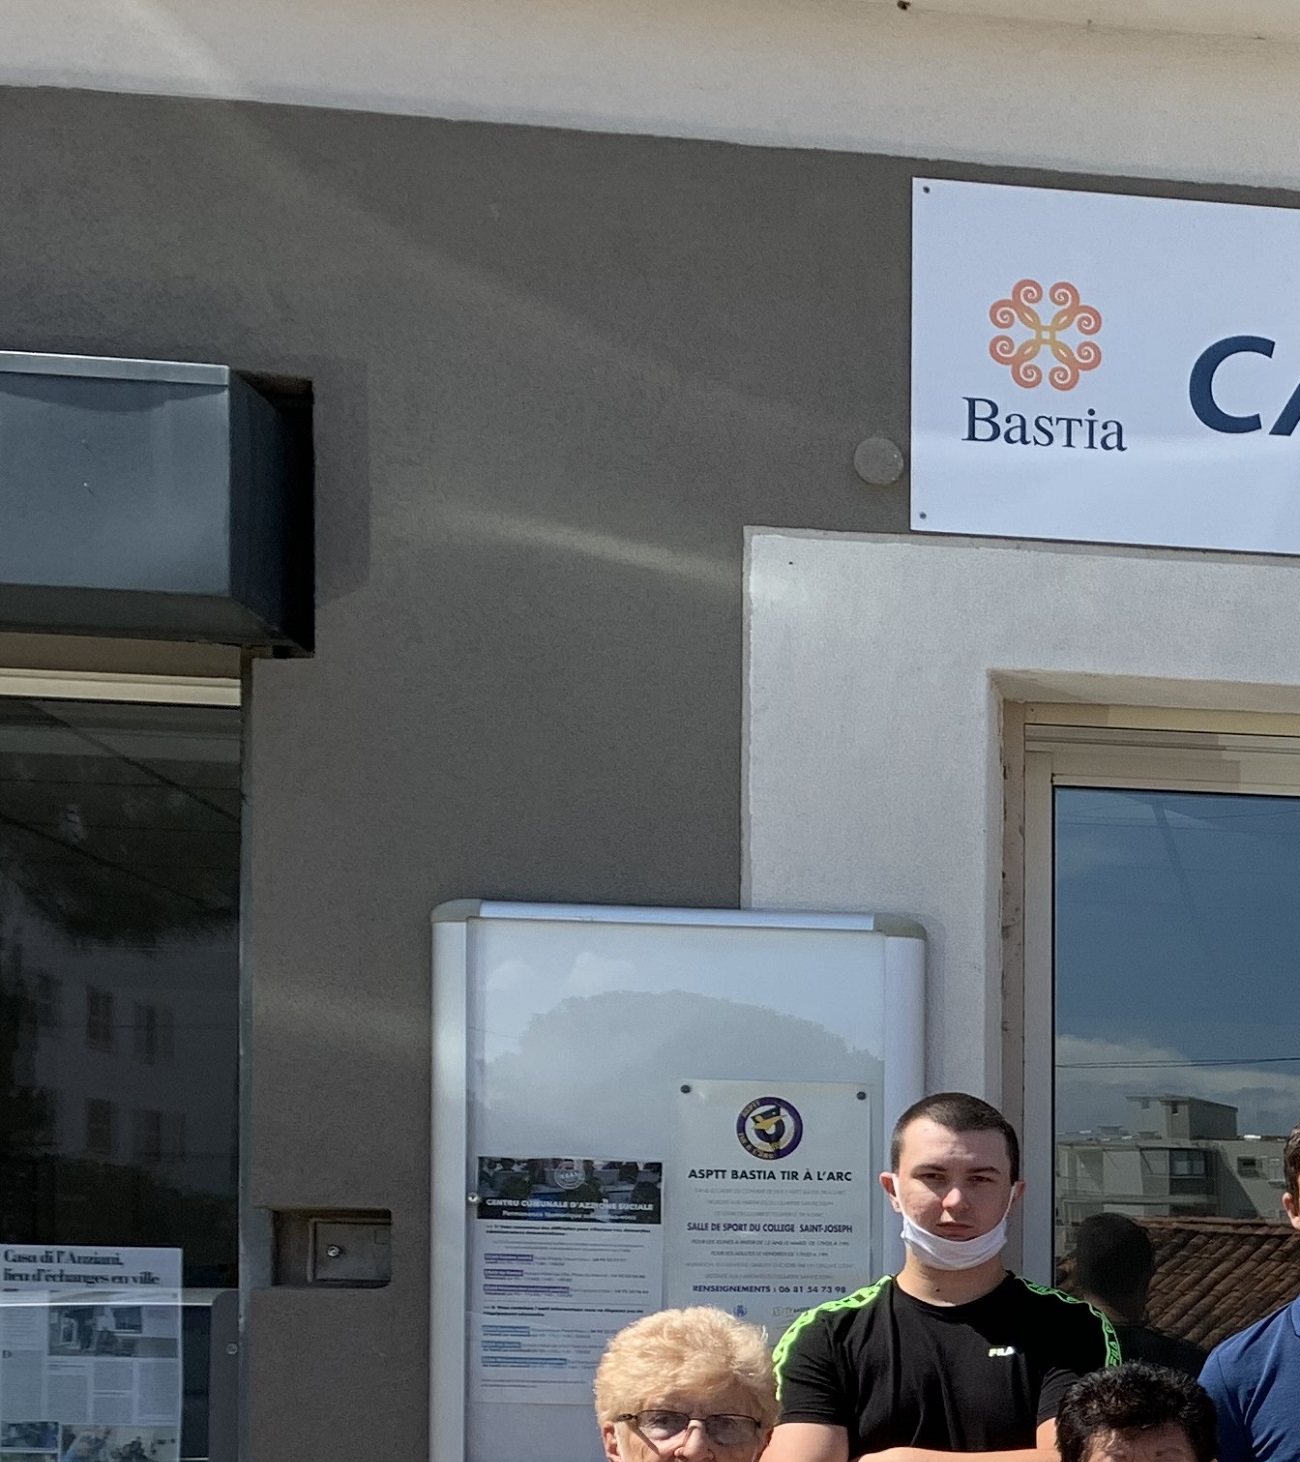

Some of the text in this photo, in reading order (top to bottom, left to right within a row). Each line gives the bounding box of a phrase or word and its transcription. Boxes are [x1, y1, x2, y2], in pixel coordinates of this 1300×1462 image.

[688, 1168, 852, 1182] ASPTT BASTIA TIR À L'ARC
[486, 1199, 520, 1207] CENTRU
[687, 1222, 853, 1234] SALLE DE SPORT DU COLLEGE SAINT-JOSEPH
[4, 1250, 37, 1263] Casa
[40, 1251, 54, 1263] di
[4, 1268, 31, 1281] lieu
[111, 1275, 129, 1284] en
[130, 1272, 161, 1284] ville
[693, 1285, 771, 1293] RENSEIGNEMENTS
[836, 1286, 847, 1294] 98
